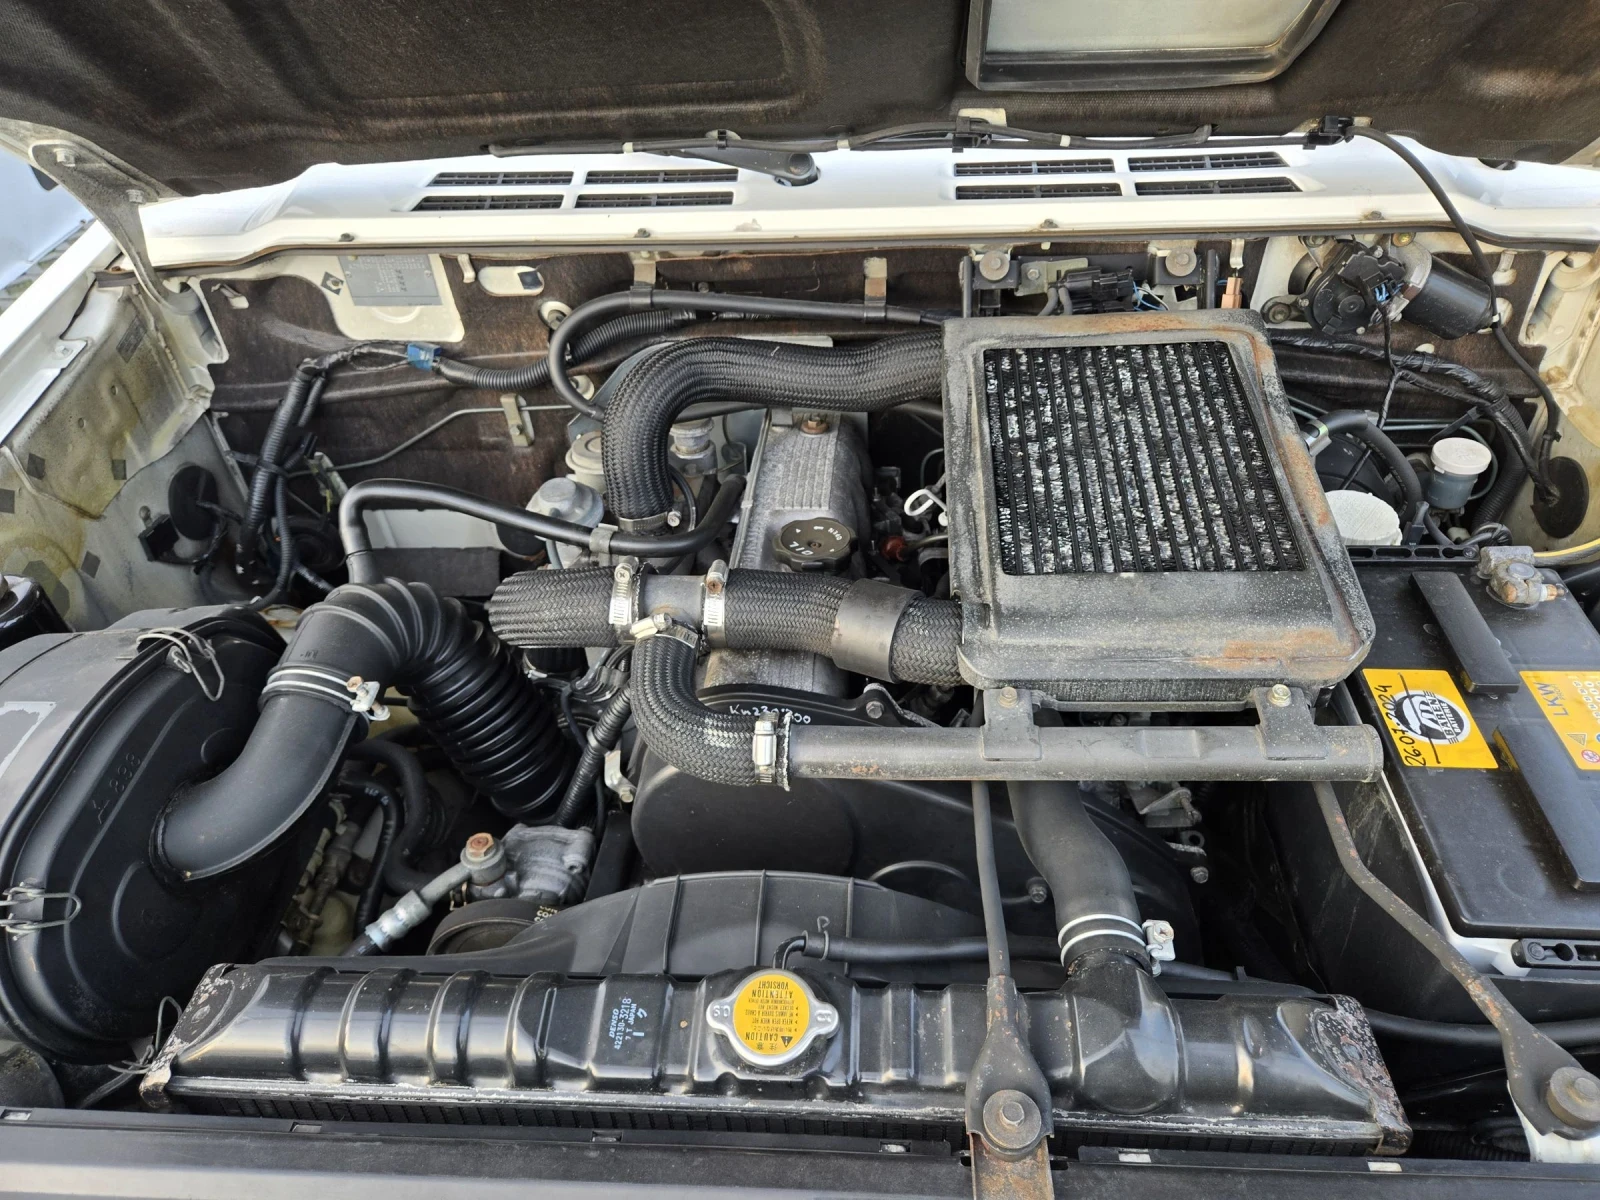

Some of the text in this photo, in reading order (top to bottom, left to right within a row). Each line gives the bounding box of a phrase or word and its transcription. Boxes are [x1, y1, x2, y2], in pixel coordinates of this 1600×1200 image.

[789, 541, 814, 555] OIL
[1533, 682, 1569, 716] LKW
[1374, 684, 1427, 767] 26.07.2024
[1440, 702, 1461, 733] BATTERIE
[752, 989, 794, 999] ATTENTION
[758, 980, 789, 990] VORSICHT
[609, 1008, 620, 1038] DENSO
[614, 997, 632, 1050] 422130-3218
[628, 1003, 637, 1025] JAPAN
[745, 1031, 778, 1042] CAUTION
